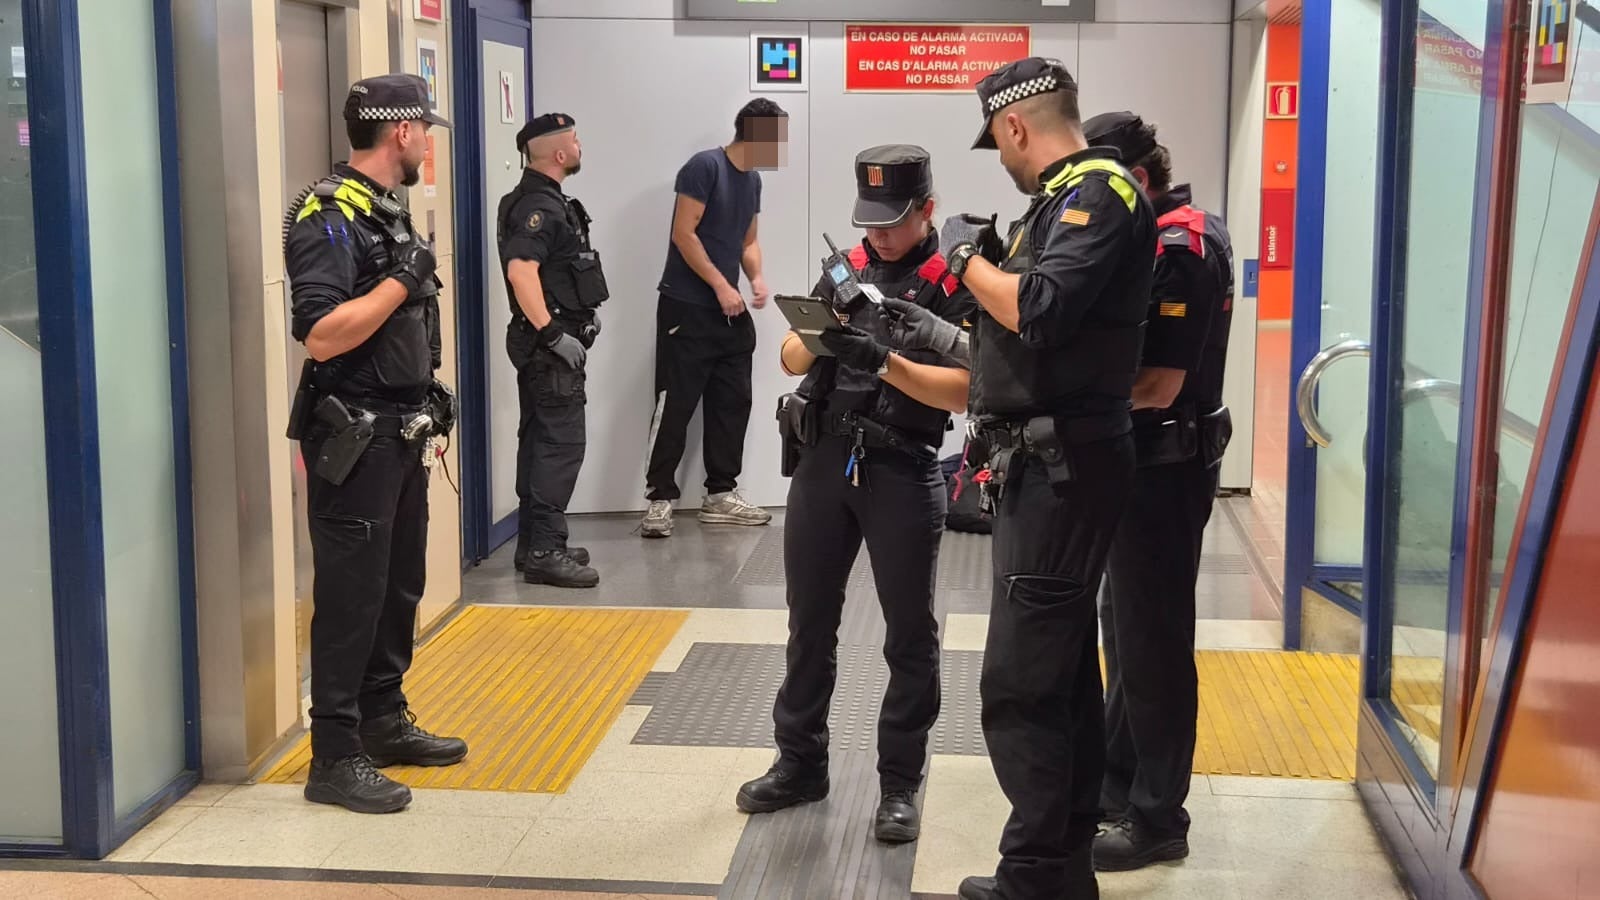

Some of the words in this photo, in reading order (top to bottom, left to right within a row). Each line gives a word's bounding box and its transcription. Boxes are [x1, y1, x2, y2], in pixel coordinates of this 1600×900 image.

[851, 32, 866, 42] EN
[869, 32, 900, 42] CASO
[903, 32, 918, 42] DE
[921, 32, 966, 42] ALARMA
[969, 32, 1024, 42] ACTIVADA
[910, 45, 926, 56] NO
[929, 45, 966, 56] PASAR
[859, 60, 875, 71] EN
[877, 60, 899, 71] CAS
[902, 60, 959, 72] D'ALARMA
[906, 74, 923, 84] NO
[926, 74, 969, 84] PASSAR
